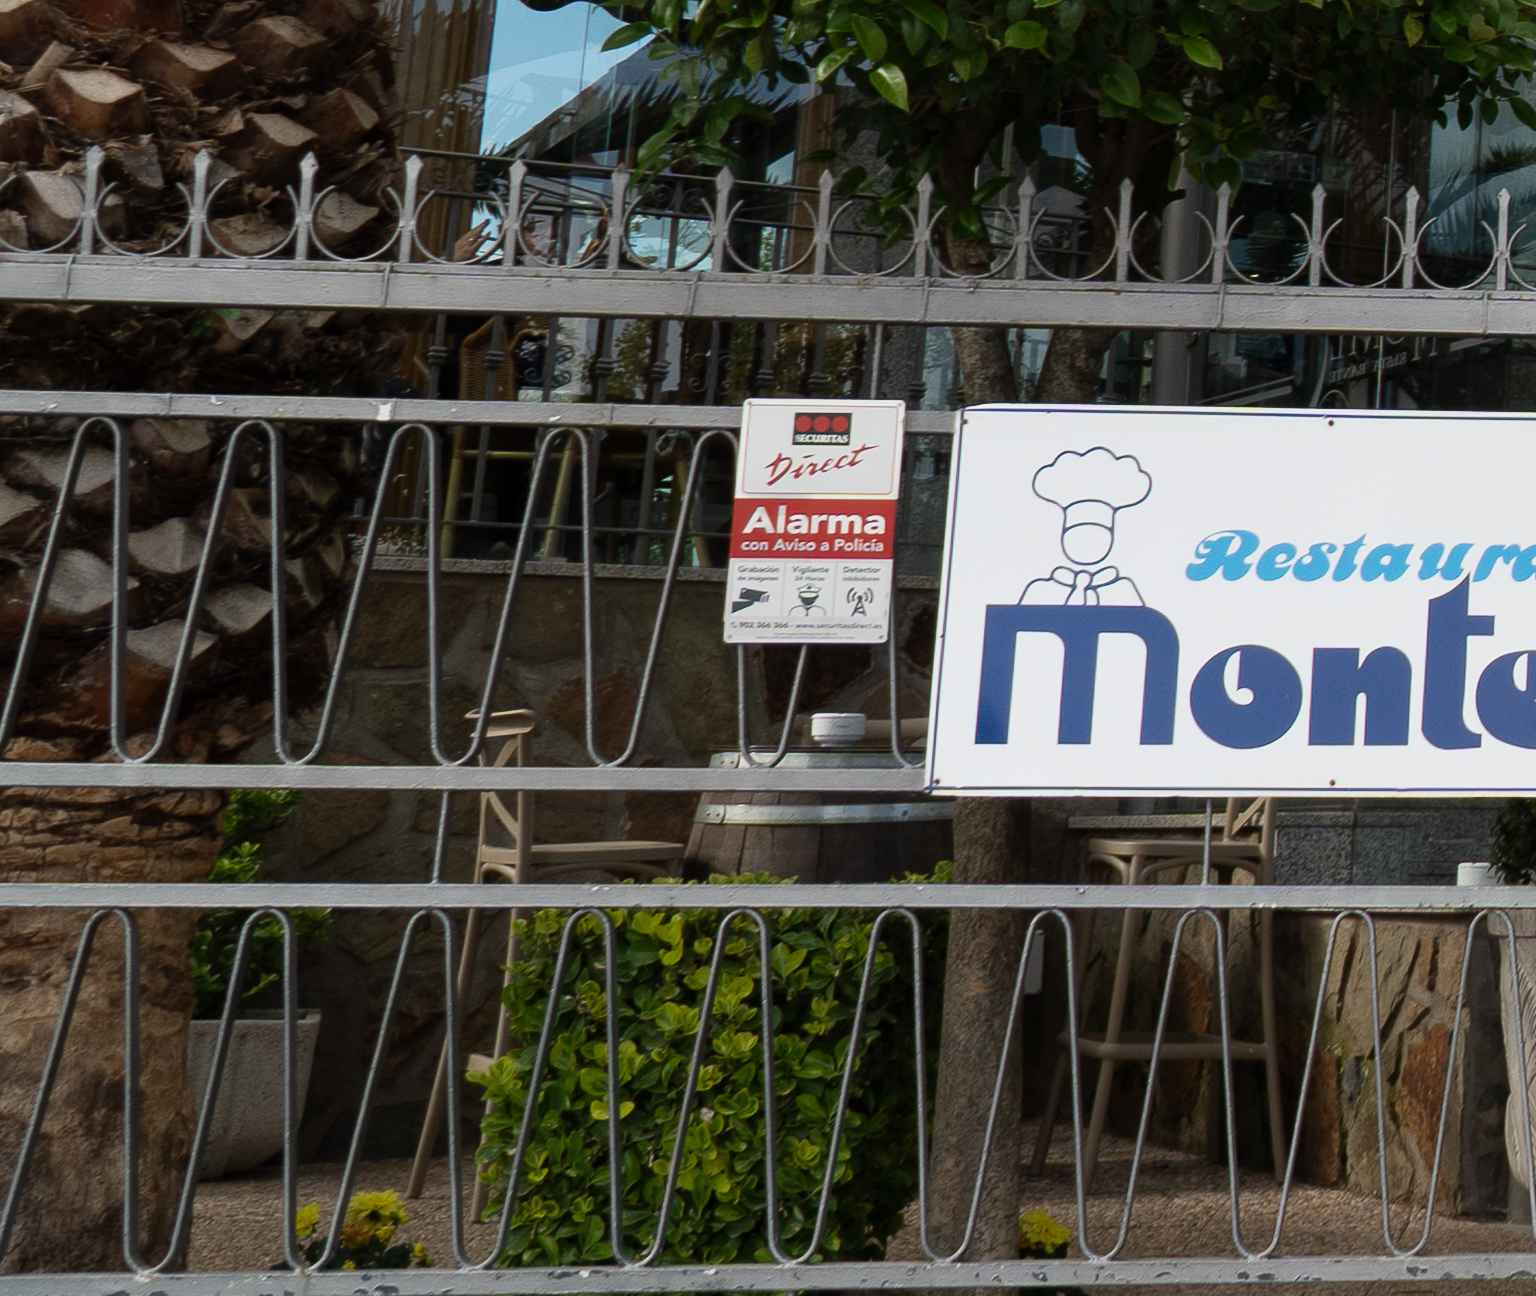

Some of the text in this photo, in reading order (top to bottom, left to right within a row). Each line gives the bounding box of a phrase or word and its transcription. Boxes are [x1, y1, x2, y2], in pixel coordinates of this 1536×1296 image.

[764, 443, 880, 487] Direct
[742, 505, 886, 536] Alarma
[740, 538, 884, 553] con Aviso a Policía
